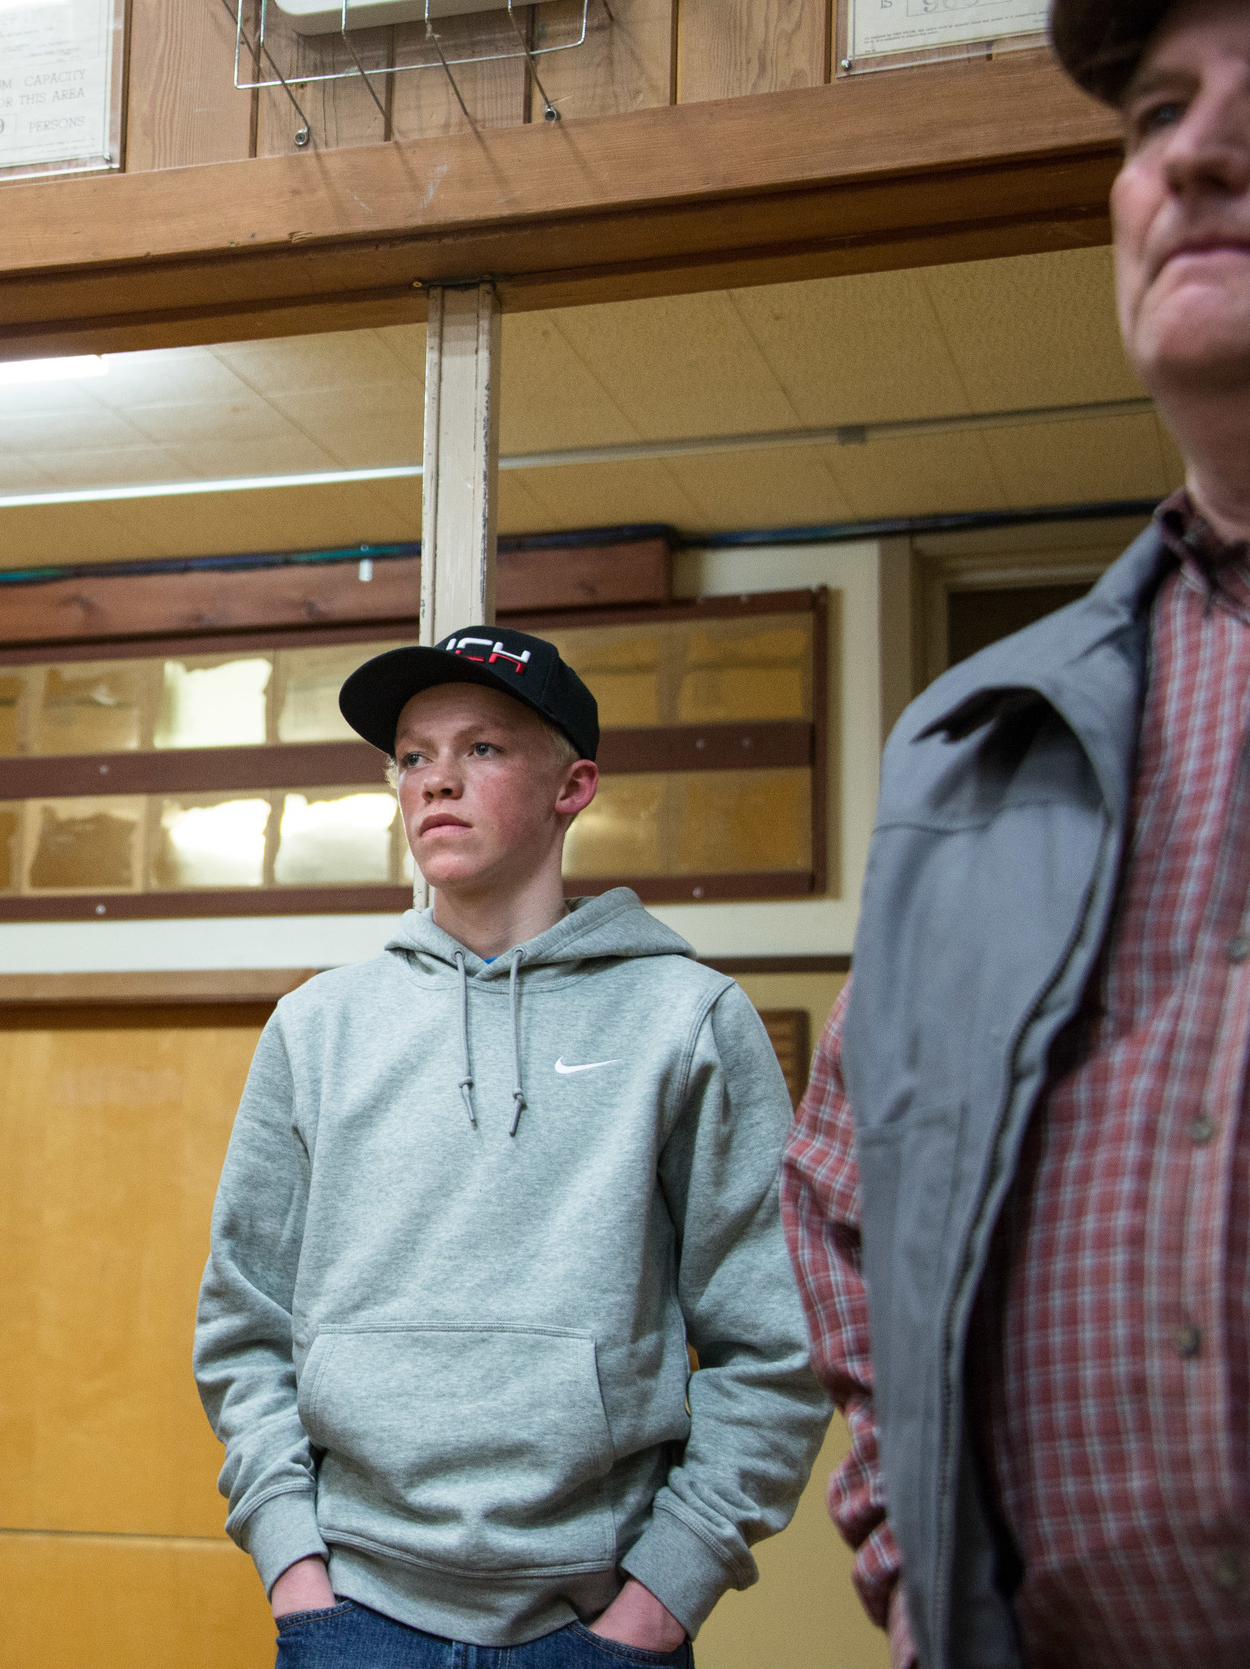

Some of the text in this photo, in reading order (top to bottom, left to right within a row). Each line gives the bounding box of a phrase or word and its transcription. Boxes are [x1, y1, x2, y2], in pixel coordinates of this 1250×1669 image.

[23, 69, 86, 87] CAPACITY
[18, 92, 47, 106] THIS
[52, 87, 85, 102] AREA
[28, 116, 85, 133] PERSONS
